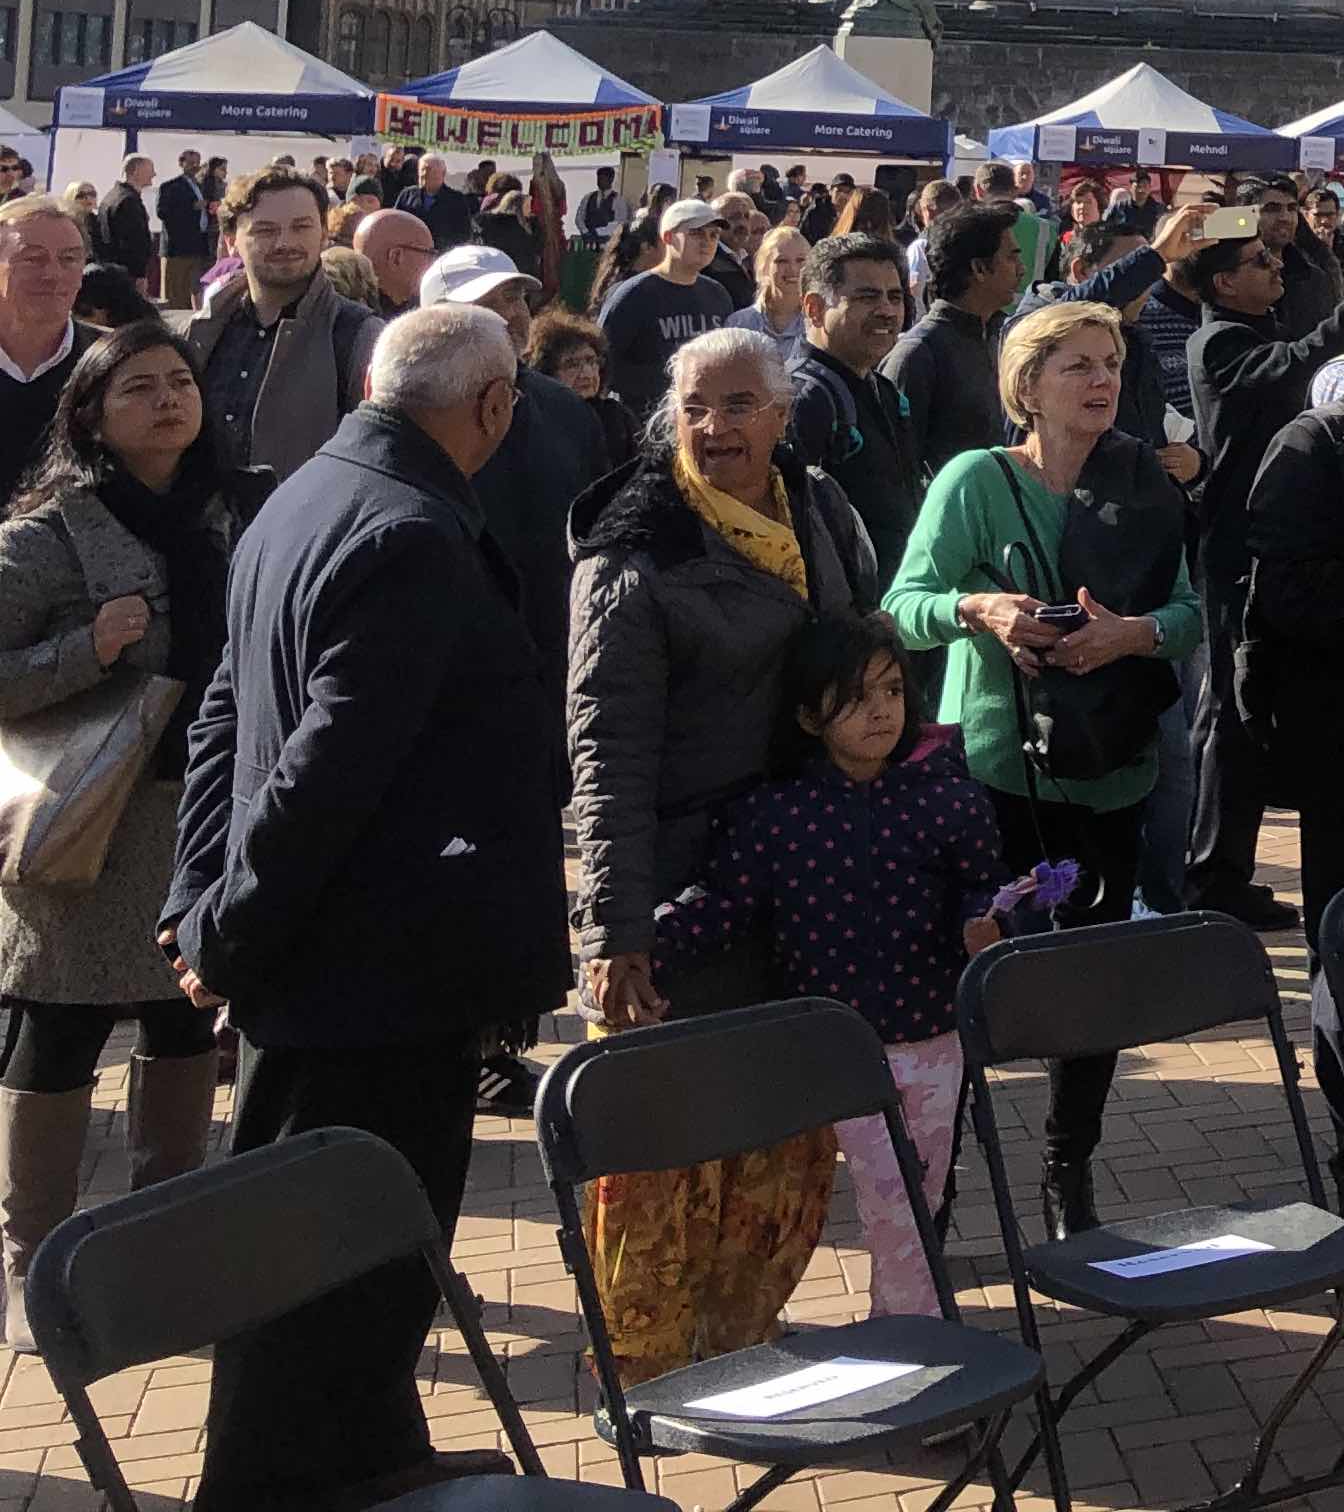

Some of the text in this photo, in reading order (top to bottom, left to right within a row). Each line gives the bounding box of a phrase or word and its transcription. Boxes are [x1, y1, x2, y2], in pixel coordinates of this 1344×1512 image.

[220, 104, 308, 119] More Catering
[728, 114, 759, 125] Diwali
[740, 126, 771, 136] square
[814, 124, 893, 139] More Catering
[1092, 135, 1121, 145] Diwali
[1189, 143, 1228, 155] Mehndi
